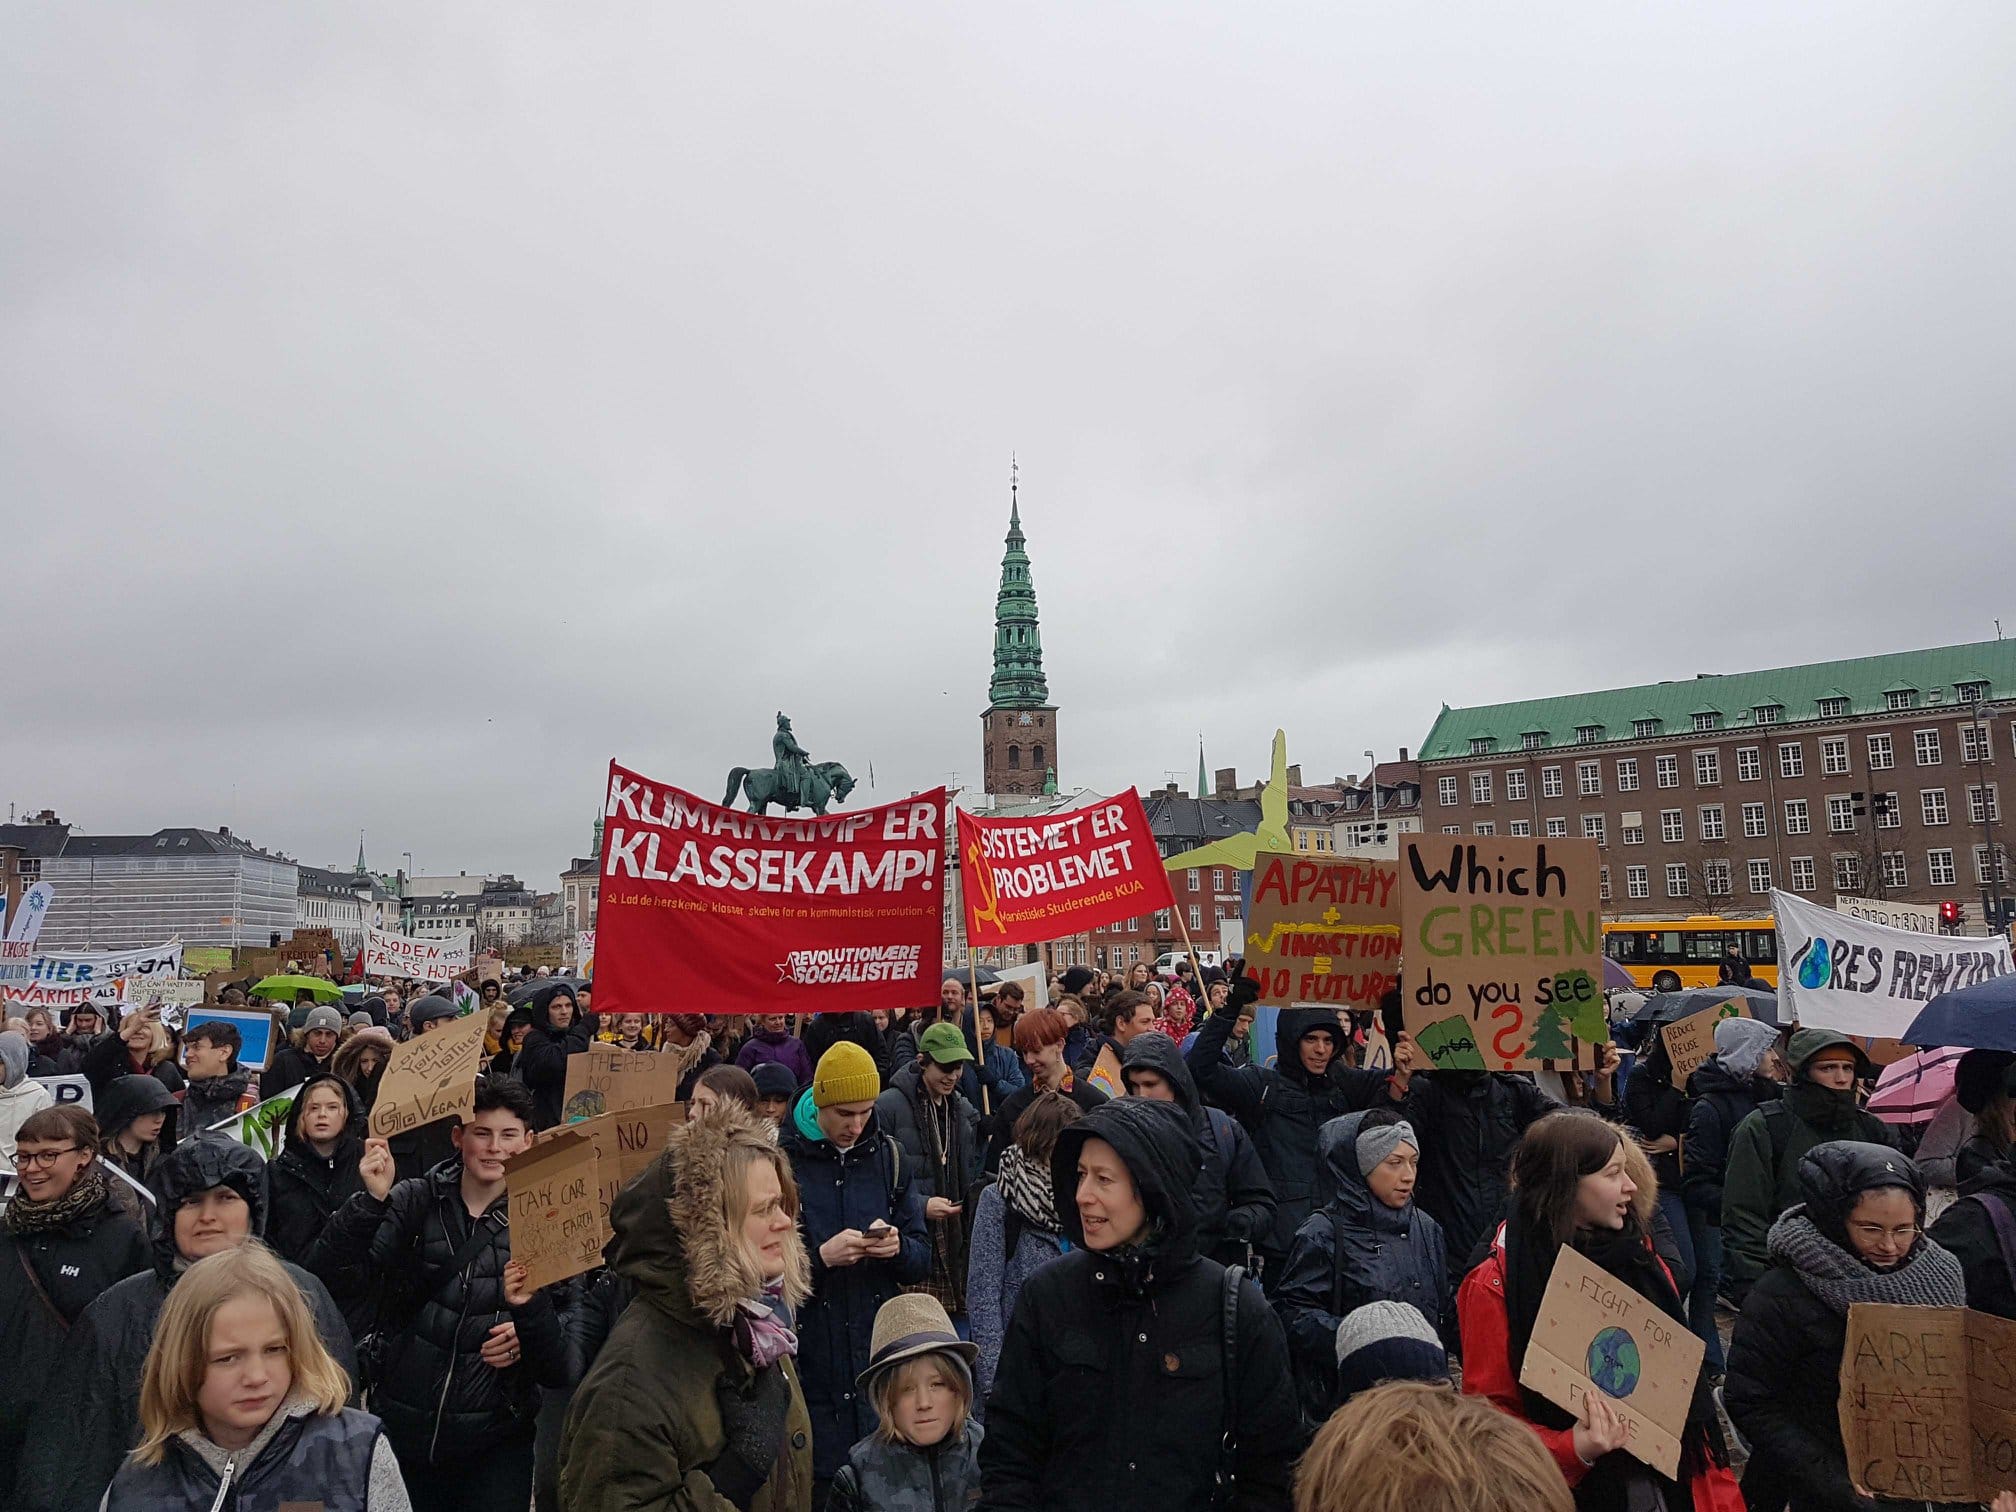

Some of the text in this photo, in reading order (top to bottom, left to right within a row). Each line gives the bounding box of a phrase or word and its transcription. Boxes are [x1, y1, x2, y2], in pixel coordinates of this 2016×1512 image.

[606, 774, 937, 843] KLIMAKAMP ER
[981, 804, 1128, 860] SYSTEMET ER
[606, 827, 937, 895] KLASSEKAMP!
[993, 839, 1133, 899] PROBLEMET
[1408, 843, 1567, 897] Which
[1255, 858, 1397, 907] APATHY
[621, 893, 639, 905] Lad
[640, 894, 652, 906] de
[654, 896, 708, 912] herskende
[748, 905, 780, 917] skælve
[782, 906, 794, 917] for
[797, 908, 807, 918] en
[810, 907, 874, 918] kommunistisk
[877, 905, 923, 917] revolution
[999, 879, 1145, 922] Marxistiske Studerende KUA
[369, 929, 440, 959] KLODEN
[1280, 933, 1402, 960] INACTION
[1419, 903, 1596, 957] GREEN
[30, 958, 94, 982] HIER
[109, 963, 130, 973] IST
[793, 945, 921, 966] REVOLUTIONÆRE
[797, 960, 919, 984] SOCIALISTER
[95, 988, 116, 998] ALS
[1247, 966, 1291, 1000] NO
[1415, 967, 1592, 1021] do you see
[1666, 1021, 1696, 1041] REDUCE
[1670, 1038, 1699, 1058] REUSE
[389, 1040, 430, 1074] LOVE
[420, 1026, 485, 1079] MOTHER
[587, 1075, 612, 1092] NO
[414, 1086, 472, 1120] VEGAN
[617, 1121, 648, 1151] NO
[514, 1181, 553, 1217] TAKE
[560, 1178, 587, 1205] CARE
[562, 1210, 594, 1238] EARTH
[581, 1237, 600, 1256] YOU
[60, 1264, 80, 1277] HH
[1579, 1275, 1672, 1348] FIGHT FOR
[1853, 1331, 1948, 1377] ARE
[1891, 1386, 1957, 1416] ACT
[1863, 1459, 1965, 1497] CARE
